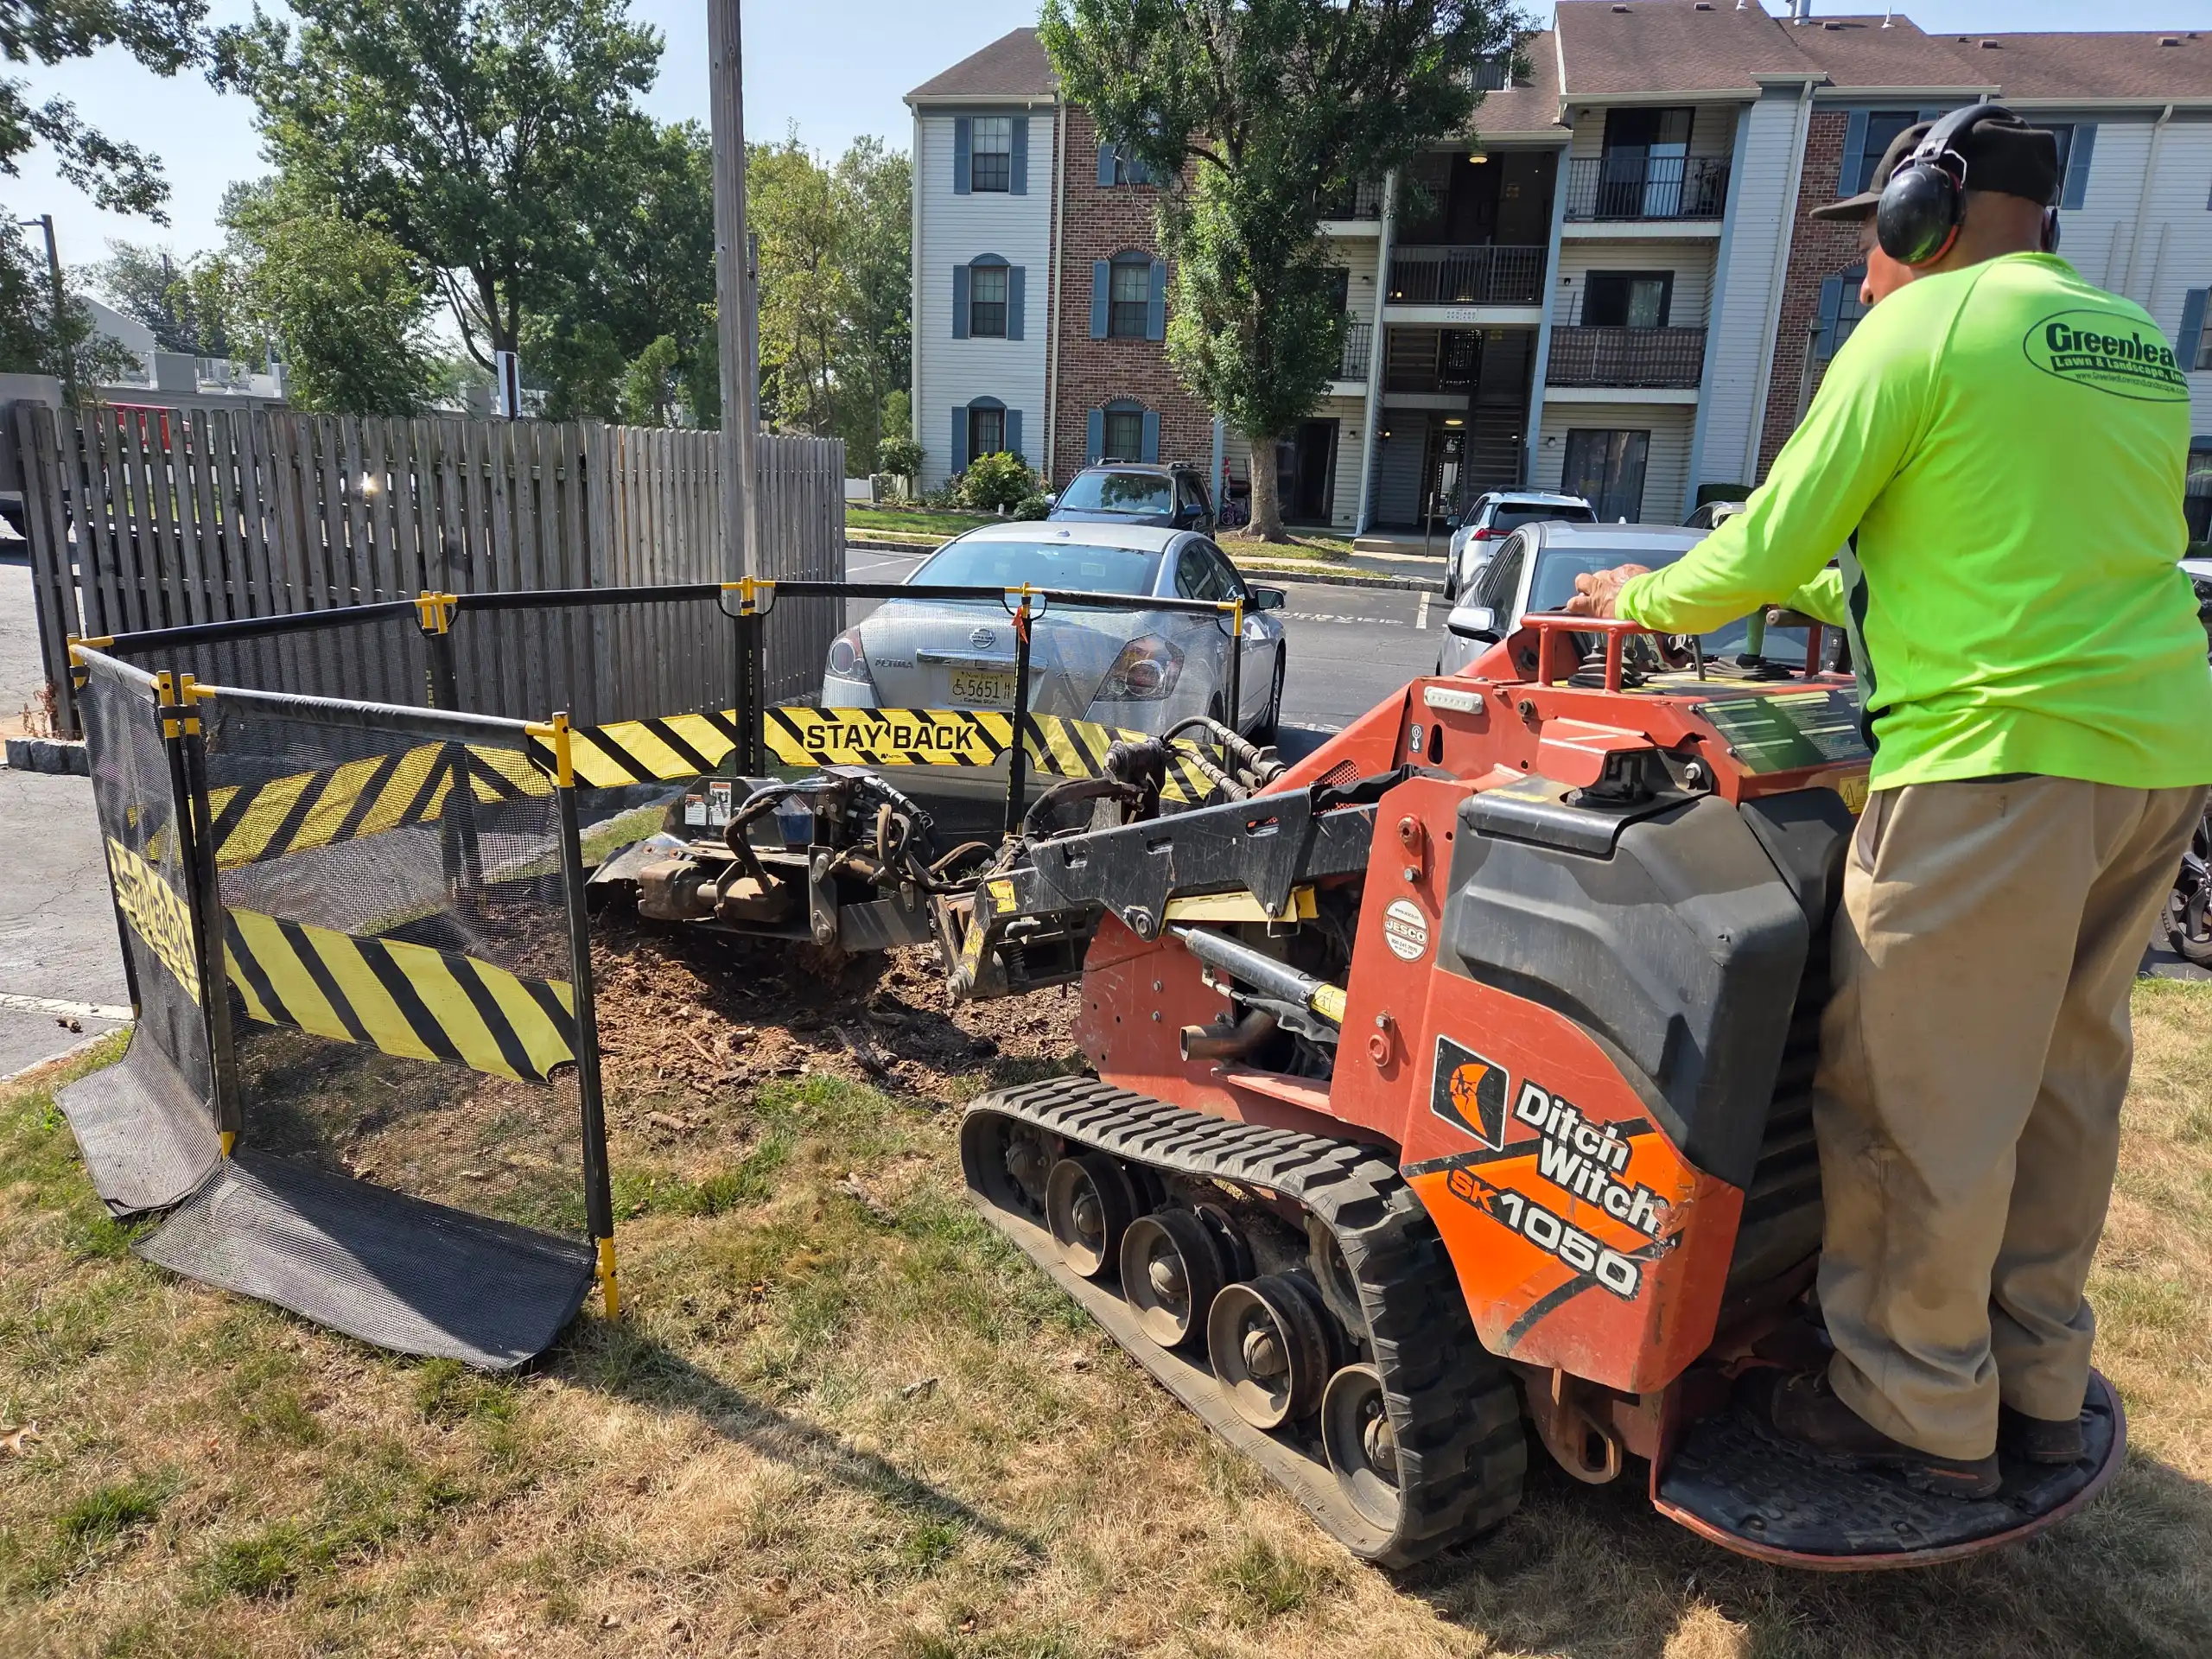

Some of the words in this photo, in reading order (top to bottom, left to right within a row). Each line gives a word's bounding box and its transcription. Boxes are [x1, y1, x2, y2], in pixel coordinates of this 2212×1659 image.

[2046, 322, 2177, 367] Greenlea
[2055, 355, 2094, 369] Lawn
[2095, 355, 2105, 368] &
[2107, 357, 2169, 380] Landscape,
[968, 680, 1000, 699] 5651
[807, 724, 884, 749] STAY
[893, 724, 976, 750] BACK
[1385, 918, 1427, 944] JESCO
[1516, 1083, 1629, 1172] Ditch
[1540, 1138, 1660, 1235] Witch
